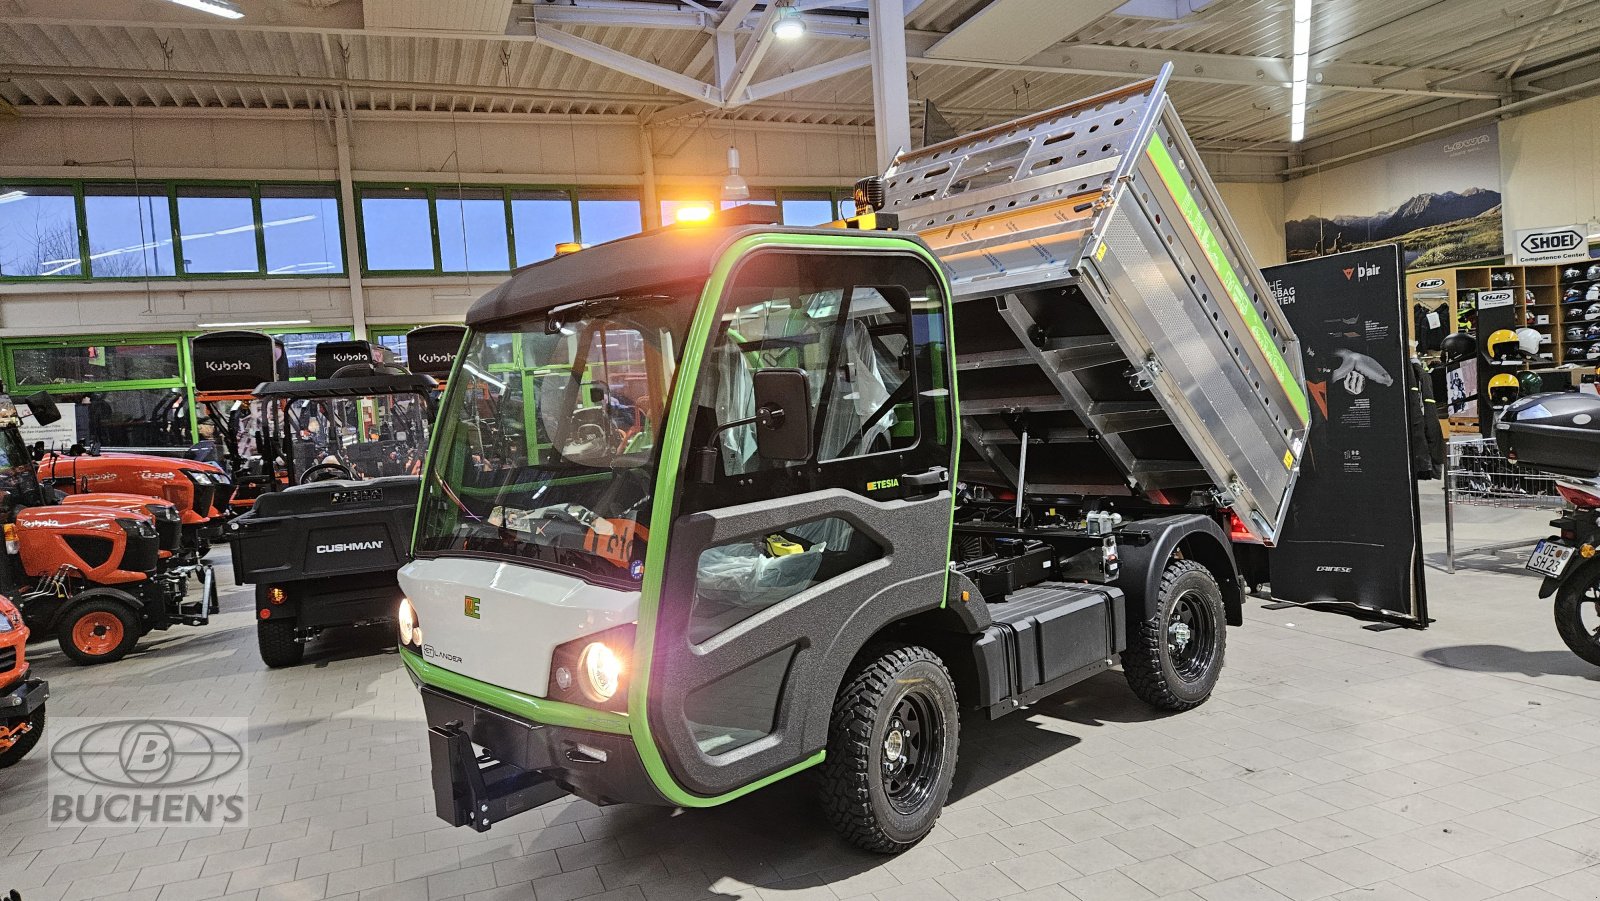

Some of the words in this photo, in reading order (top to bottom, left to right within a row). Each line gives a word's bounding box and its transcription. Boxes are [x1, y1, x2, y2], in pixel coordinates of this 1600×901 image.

[1531, 234, 1574, 250] SHOEI
[1521, 254, 1562, 262] Competence
[1268, 280, 1282, 290] HE
[1272, 286, 1296, 298] RBAG
[333, 352, 368, 362] Kubota
[206, 360, 251, 371] Kubota
[867, 478, 899, 491] ETESIA
[316, 541, 383, 554] CUSHMAN
[1543, 544, 1557, 557] OE
[1533, 555, 1547, 569] SH
[1547, 559, 1560, 572] 23
[434, 652, 462, 663] LANDER
